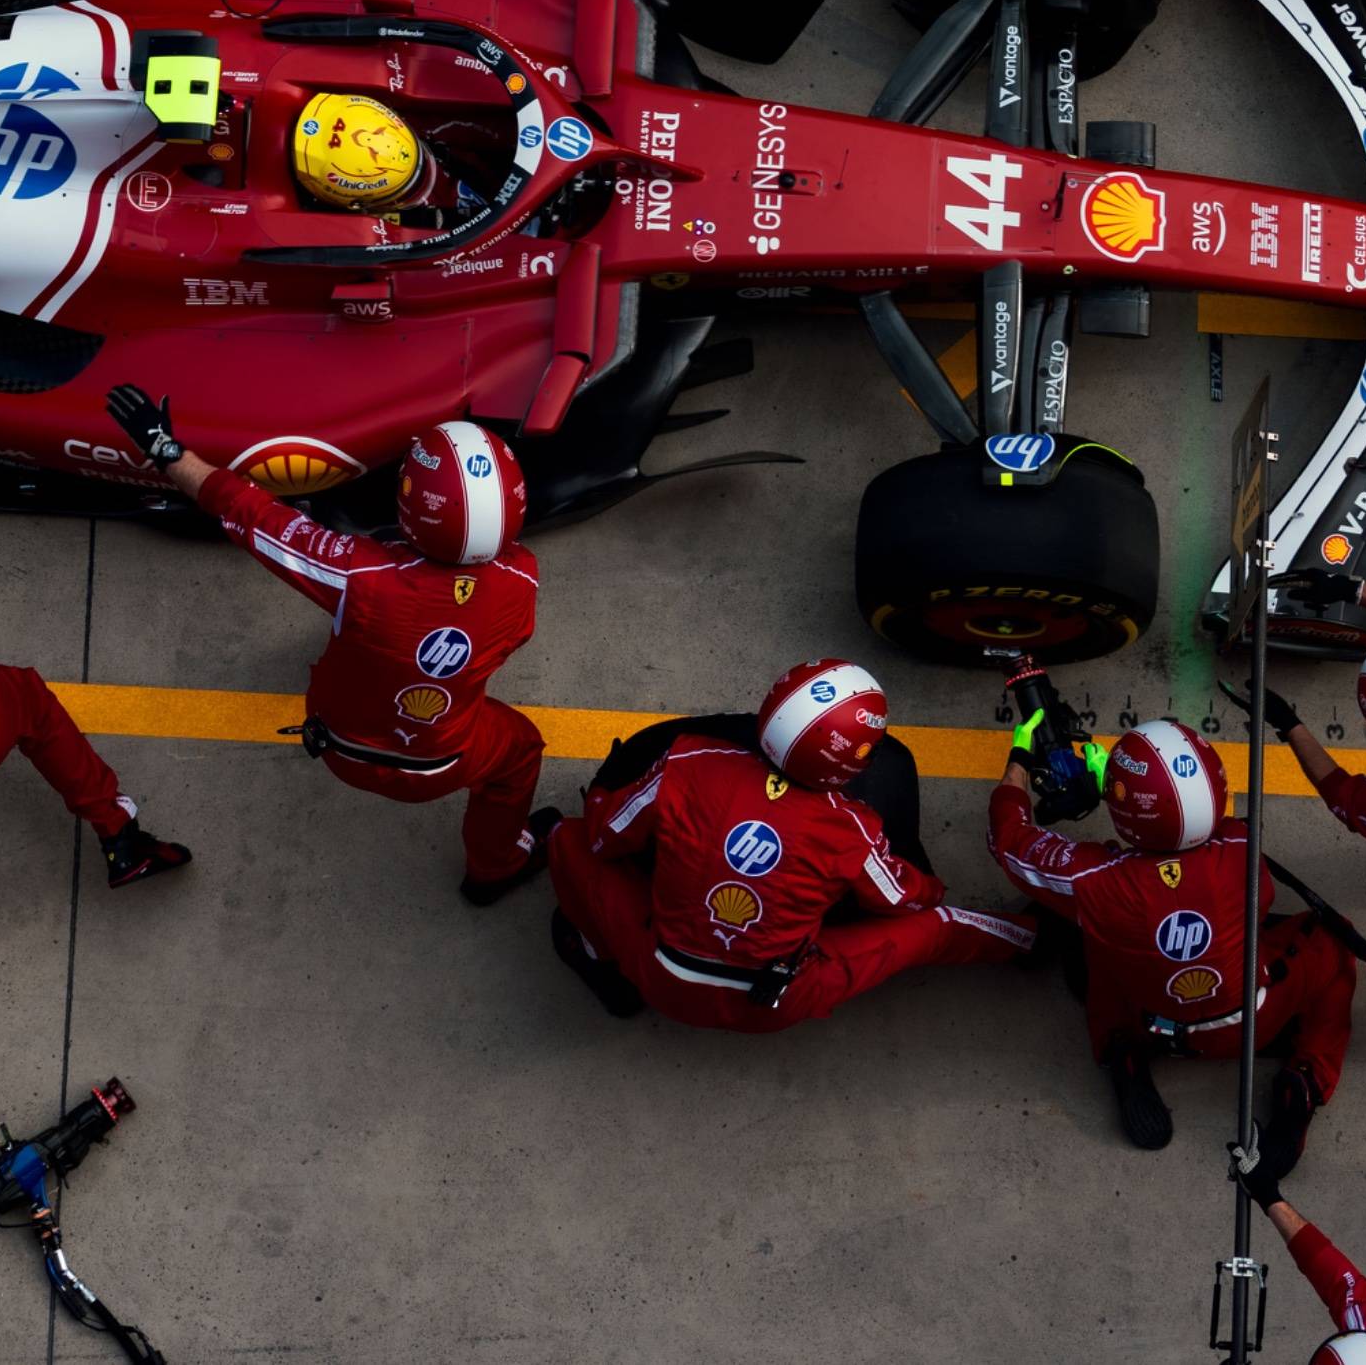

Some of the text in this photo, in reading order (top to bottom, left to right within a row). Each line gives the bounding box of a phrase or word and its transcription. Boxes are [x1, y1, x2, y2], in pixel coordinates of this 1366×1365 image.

[480, 40, 502, 60] aws
[1004, 25, 1021, 86] vantage
[1058, 48, 1073, 125] ESPACIO
[303, 118, 320, 135] hp
[329, 118, 345, 149] 44
[520, 126, 542, 148] hp
[547, 117, 593, 161] hp
[338, 178, 387, 190] UniCredit
[635, 111, 650, 229] NASTR AZZURRO
[753, 104, 787, 230] GENESYS
[494, 174, 522, 205] IBM
[944, 154, 1023, 251] 44
[452, 208, 491, 236] RICHARD
[1191, 201, 1212, 253] aws
[1250, 202, 1278, 268] IBM
[1355, 215, 1366, 265] CELSIUS
[1302, 202, 1322, 283] PIRELLI
[450, 258, 503, 275] ambipar
[856, 265, 929, 276] MILLE
[183, 277, 269, 306] IBM
[343, 300, 391, 316] aws
[994, 301, 1011, 369] vantage
[1043, 340, 1067, 423] ESPACIO
[1210, 352, 1223, 402] AXLE
[467, 455, 491, 478] hp
[988, 433, 1054, 471] hp
[80, 467, 179, 490] PERON
[963, 586, 1083, 606] ZERO
[417, 627, 471, 678] hp
[810, 680, 836, 703] hp
[1172, 754, 1197, 778] hp
[726, 820, 781, 876] hp
[1157, 911, 1211, 960] hp
